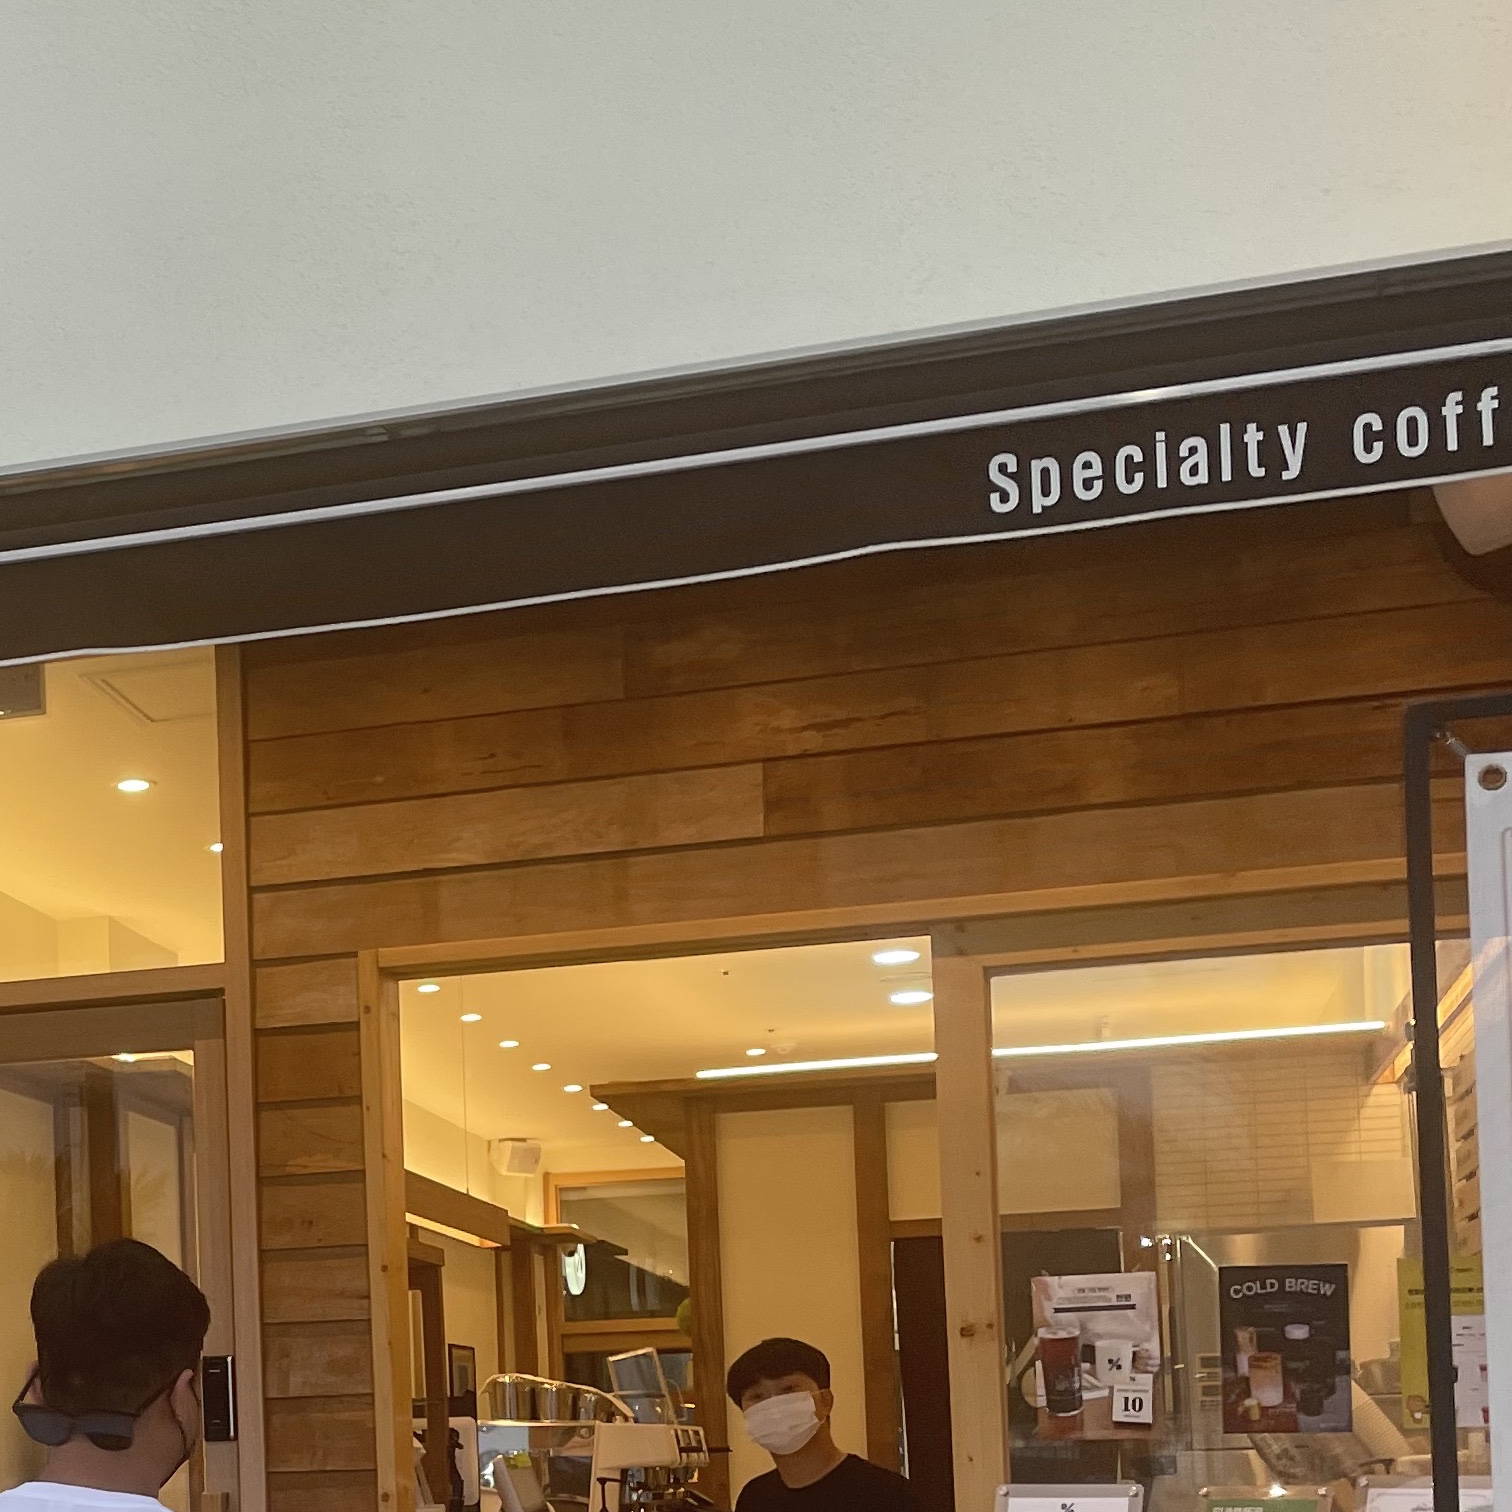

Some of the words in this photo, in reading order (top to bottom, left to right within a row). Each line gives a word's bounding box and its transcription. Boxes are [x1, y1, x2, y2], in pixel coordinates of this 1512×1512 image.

[988, 421, 1308, 514] Specialty
[1352, 386, 1500, 465] coff
[1229, 1278, 1279, 1298] COLD
[1285, 1278, 1336, 1296] BREW
[1122, 1396, 1144, 1412] 10
